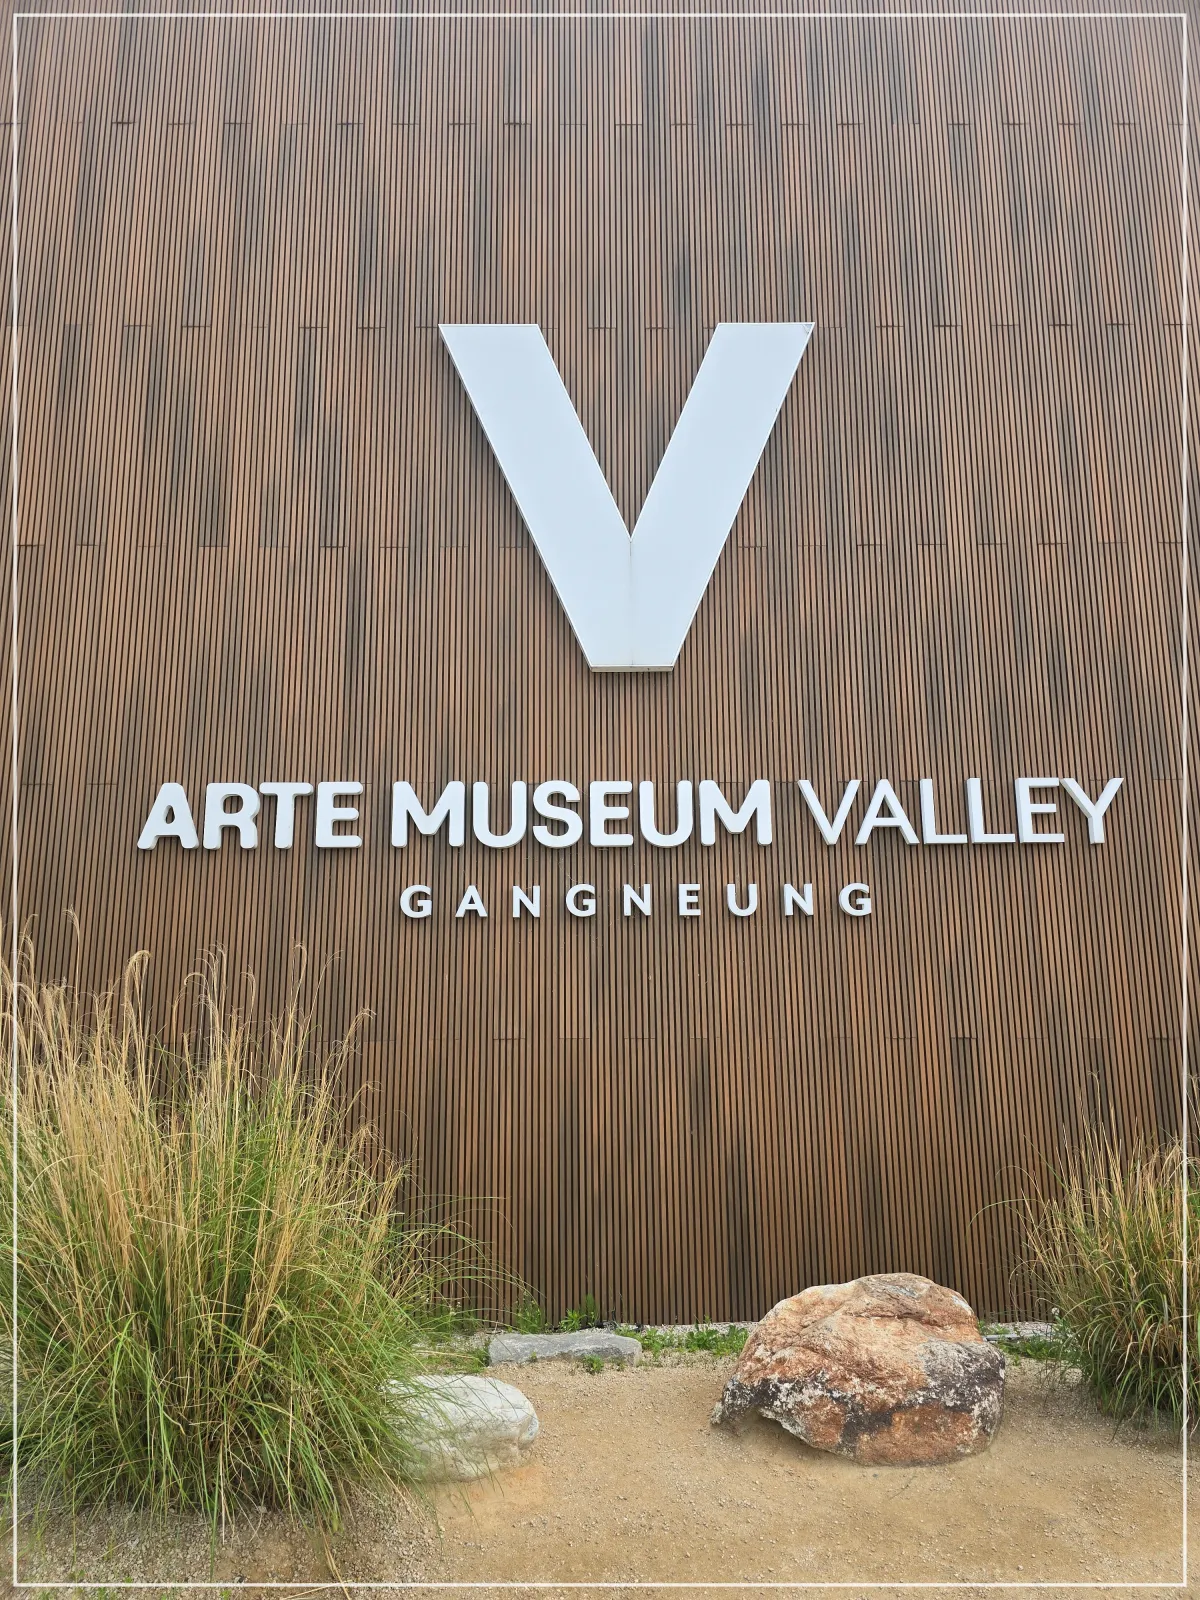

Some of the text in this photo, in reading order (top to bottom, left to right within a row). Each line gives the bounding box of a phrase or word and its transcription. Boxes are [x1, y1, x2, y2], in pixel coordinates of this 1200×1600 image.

[438, 322, 815, 673] V
[136, 776, 1126, 850] ARTE MUSEUM VALLEY
[399, 882, 874, 919] GANGNEUNG
